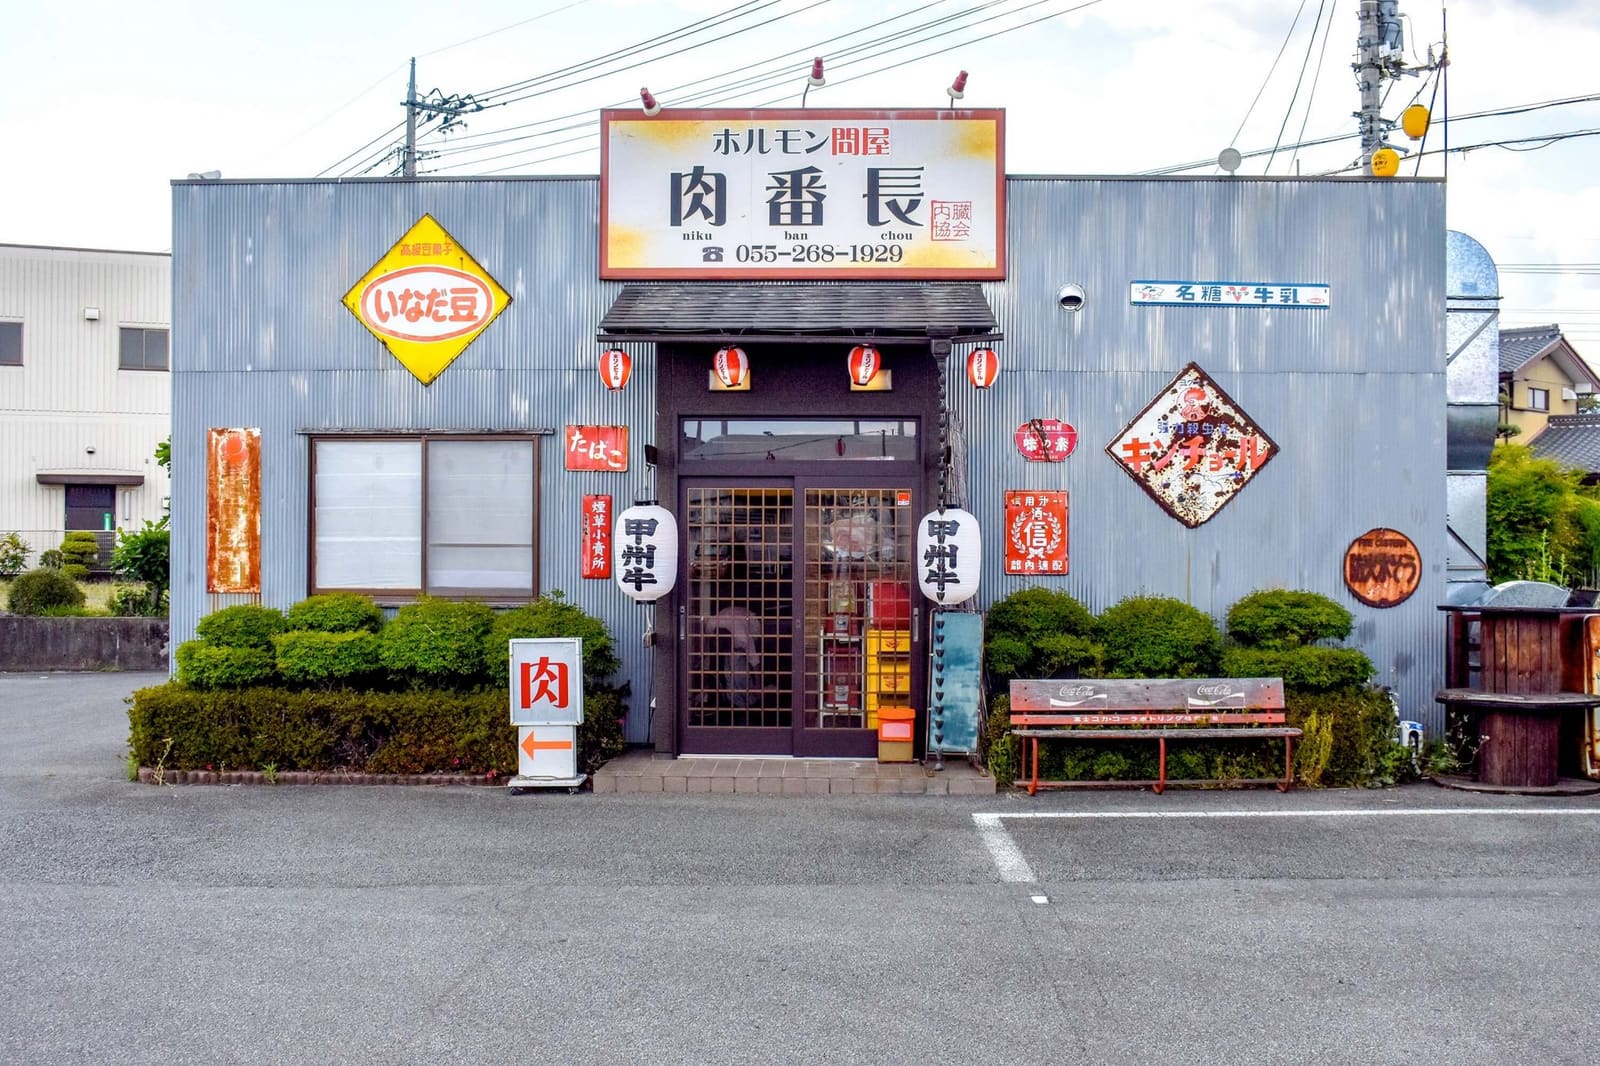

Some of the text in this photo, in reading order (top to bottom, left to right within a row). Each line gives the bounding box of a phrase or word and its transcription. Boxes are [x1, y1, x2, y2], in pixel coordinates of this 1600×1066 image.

[712, 127, 890, 156] ホルモン問屋
[669, 165, 925, 227] 肉番長
[934, 203, 970, 220] 内臓
[682, 230, 913, 241] niku ban chou
[933, 221, 970, 237] 協会
[735, 244, 904, 264] 055-268-1929
[374, 287, 479, 324] いなだ豆
[1175, 285, 1223, 302] 名糖
[1253, 287, 1301, 304] 牛乳
[570, 430, 623, 468] たばこ
[1023, 437, 1069, 452] 味の素
[1122, 435, 1269, 473] キンチョール
[1023, 521, 1048, 547] 信
[622, 518, 659, 591] 甲州牛
[924, 519, 960, 591] 甲州牛
[520, 656, 569, 709] 肉
